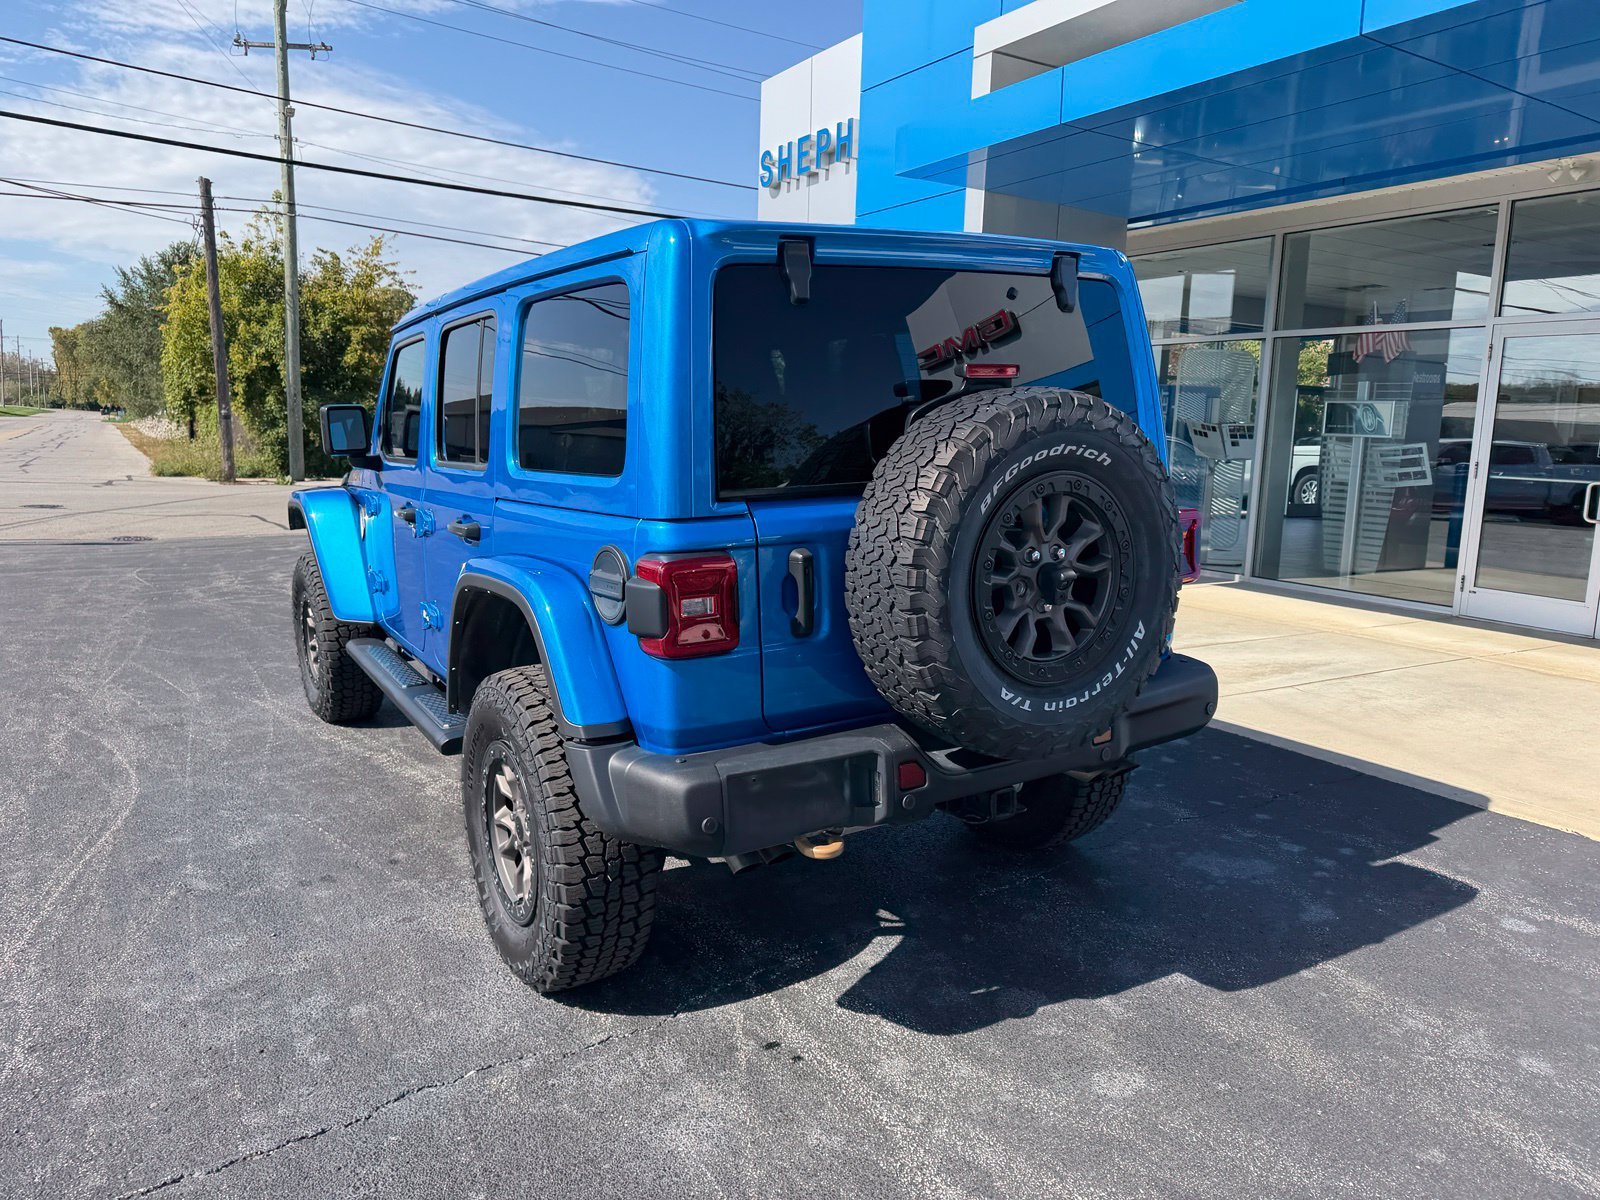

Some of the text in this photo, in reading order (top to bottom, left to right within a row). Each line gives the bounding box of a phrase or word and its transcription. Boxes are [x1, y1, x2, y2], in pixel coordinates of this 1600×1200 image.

[760, 117, 855, 188] SHEPH
[980, 443, 1113, 516] BFGoodrich
[1000, 619, 1146, 713] All-Terrain T/A
